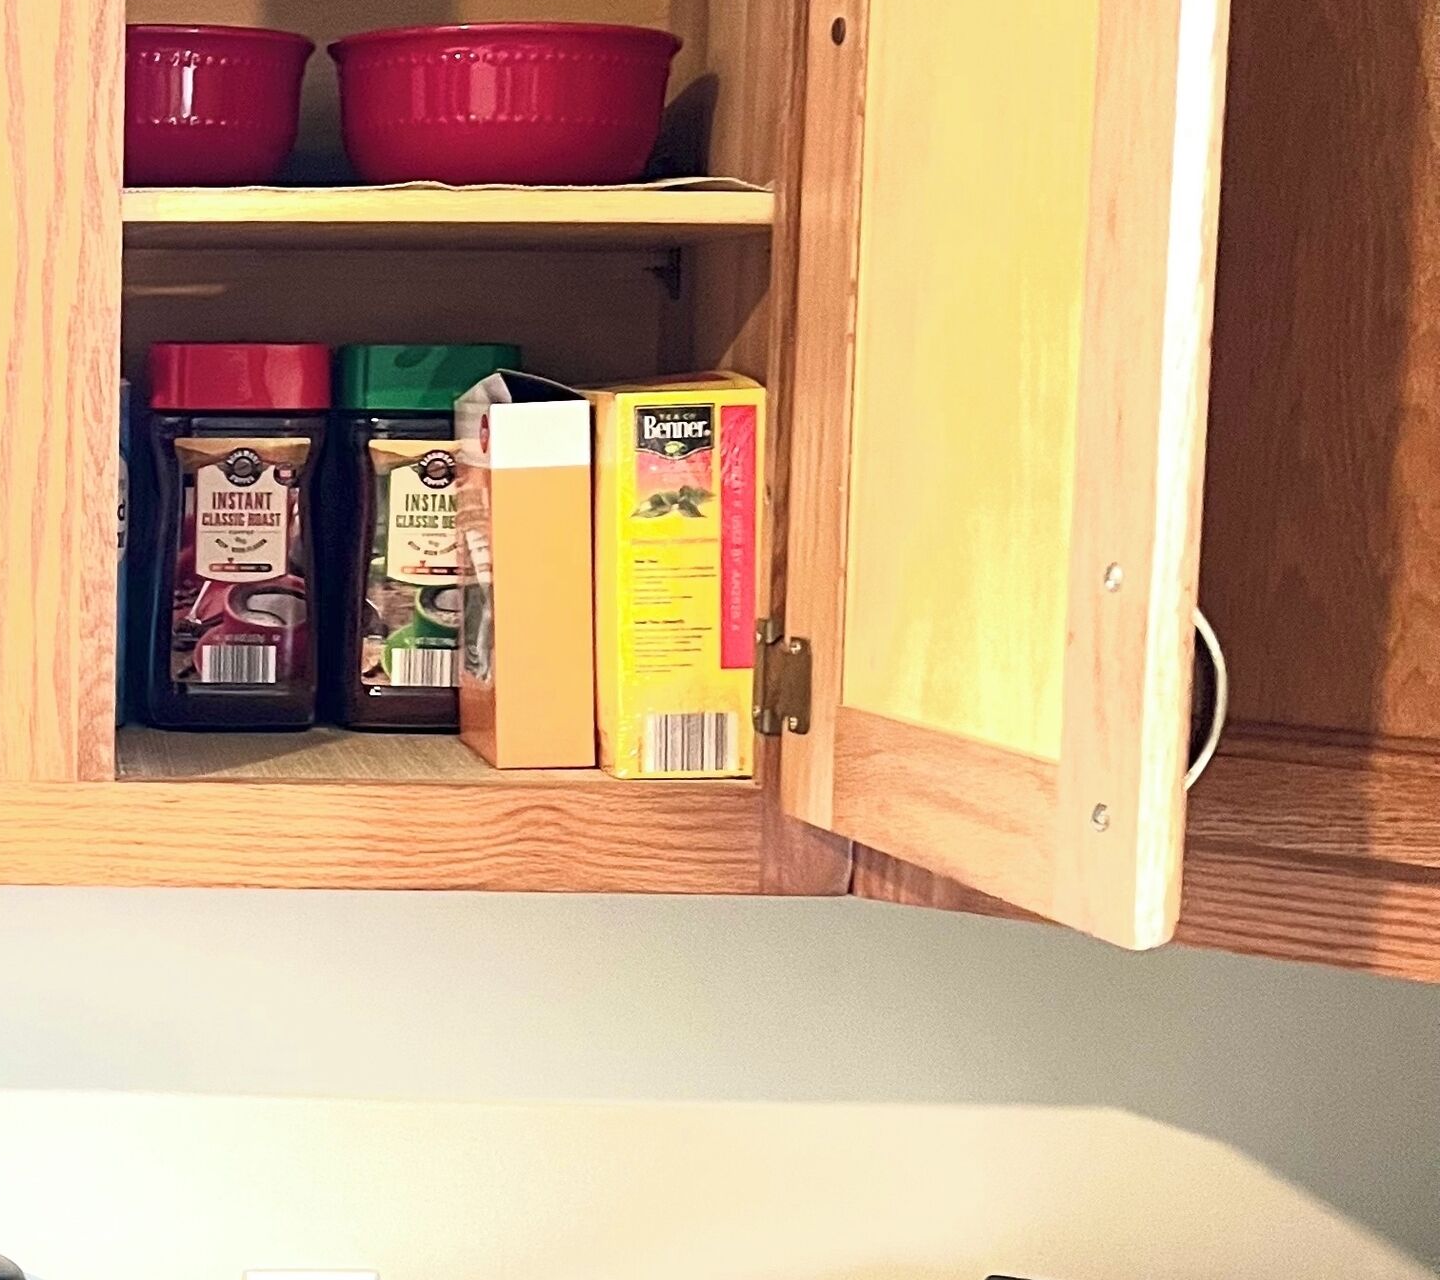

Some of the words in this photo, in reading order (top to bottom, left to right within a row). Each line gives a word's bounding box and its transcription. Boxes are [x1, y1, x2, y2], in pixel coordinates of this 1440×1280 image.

[643, 415, 708, 439] Benner
[212, 491, 273, 510] INSTANT
[405, 493, 458, 512] INSTAN
[201, 512, 245, 527] CLASSIC
[247, 512, 281, 527] ROAST
[395, 514, 439, 529] CLASSIC
